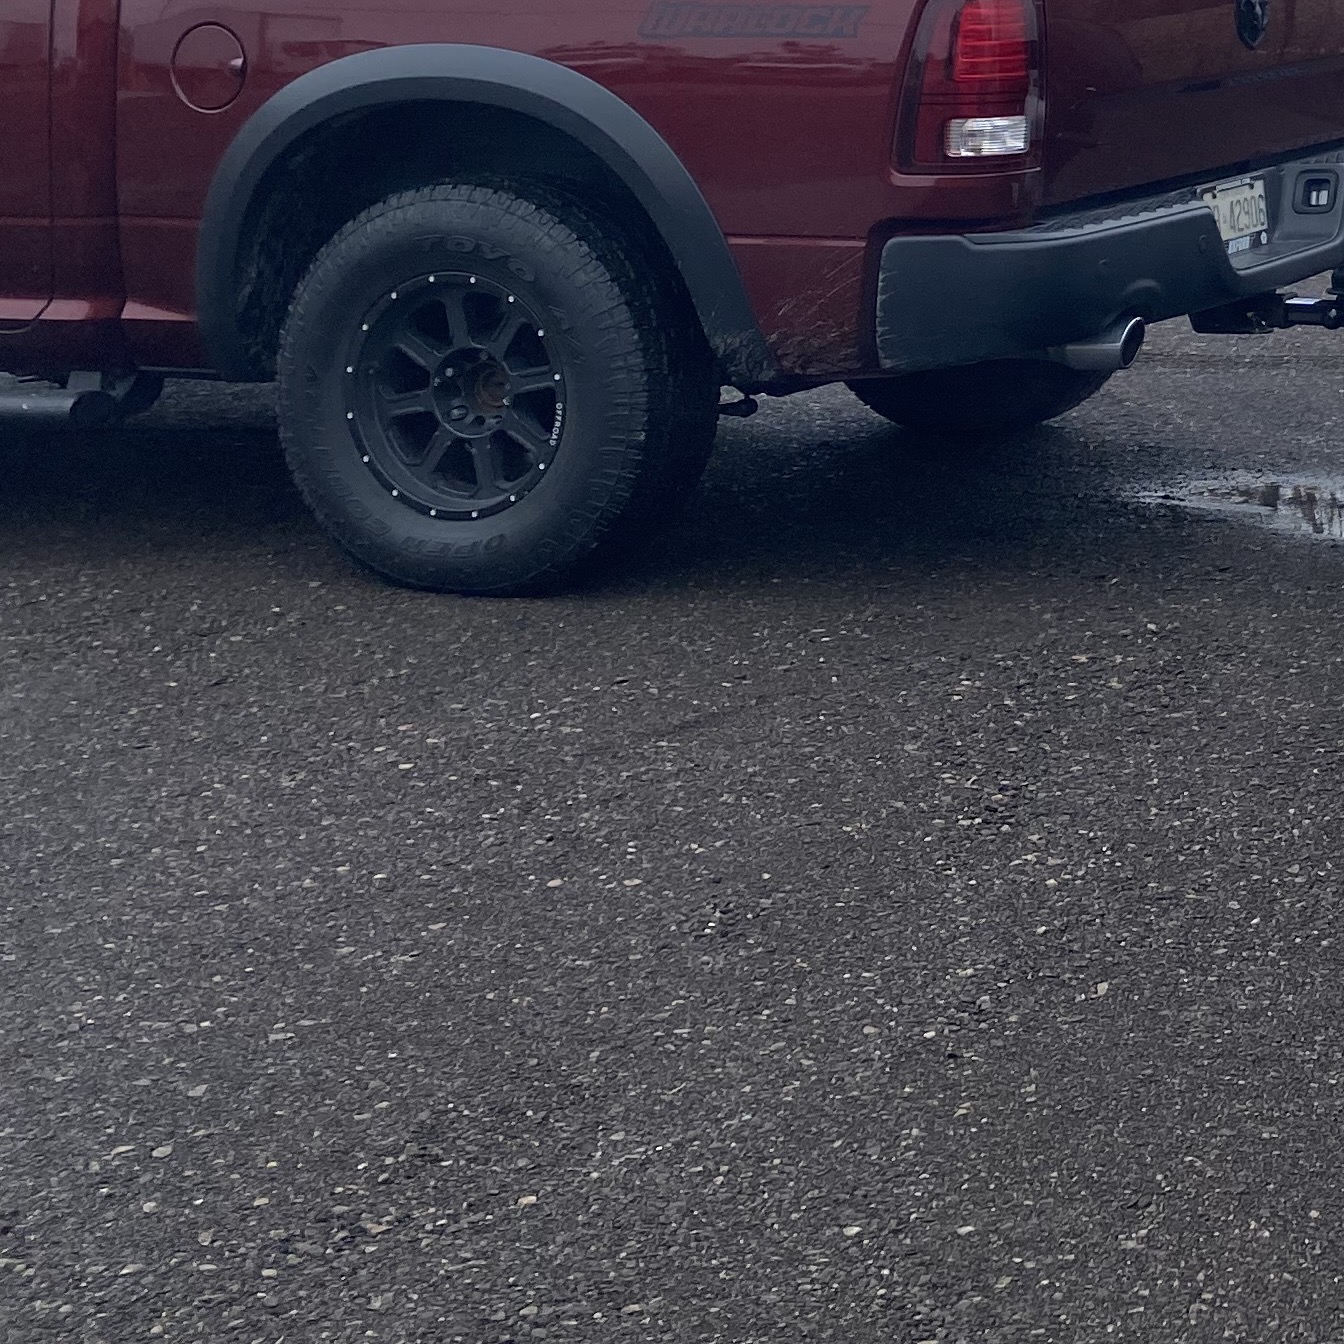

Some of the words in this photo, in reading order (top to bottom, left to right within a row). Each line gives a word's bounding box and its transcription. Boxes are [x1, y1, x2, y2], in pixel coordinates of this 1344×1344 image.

[639, 1, 871, 38] WARLOCK
[1228, 193, 1266, 233] 42906
[413, 233, 536, 283] TOYO
[549, 401, 563, 446] OFFROAD
